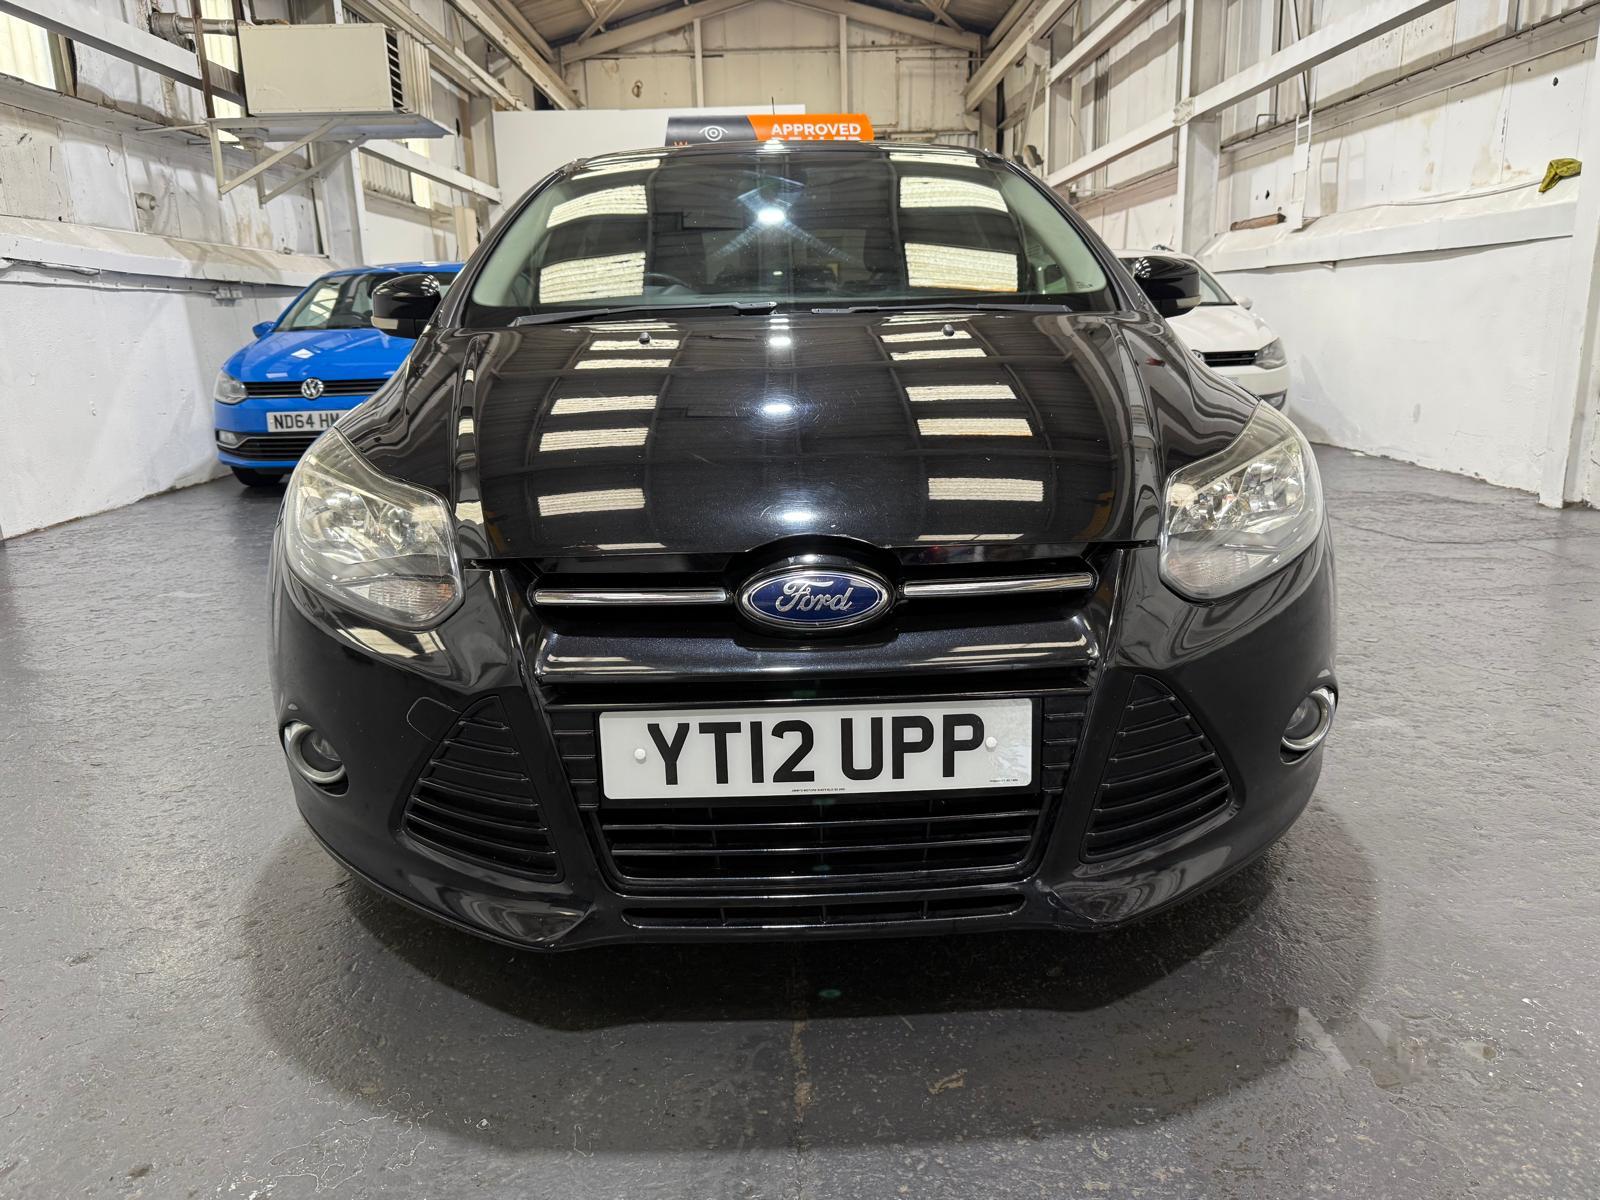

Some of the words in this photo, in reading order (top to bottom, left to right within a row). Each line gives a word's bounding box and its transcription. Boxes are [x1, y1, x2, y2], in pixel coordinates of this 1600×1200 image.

[771, 123, 861, 136] APPROVED
[273, 414, 315, 430] ND64
[775, 579, 854, 613] Ford
[647, 719, 815, 785] YT12
[841, 713, 985, 781] UPP
